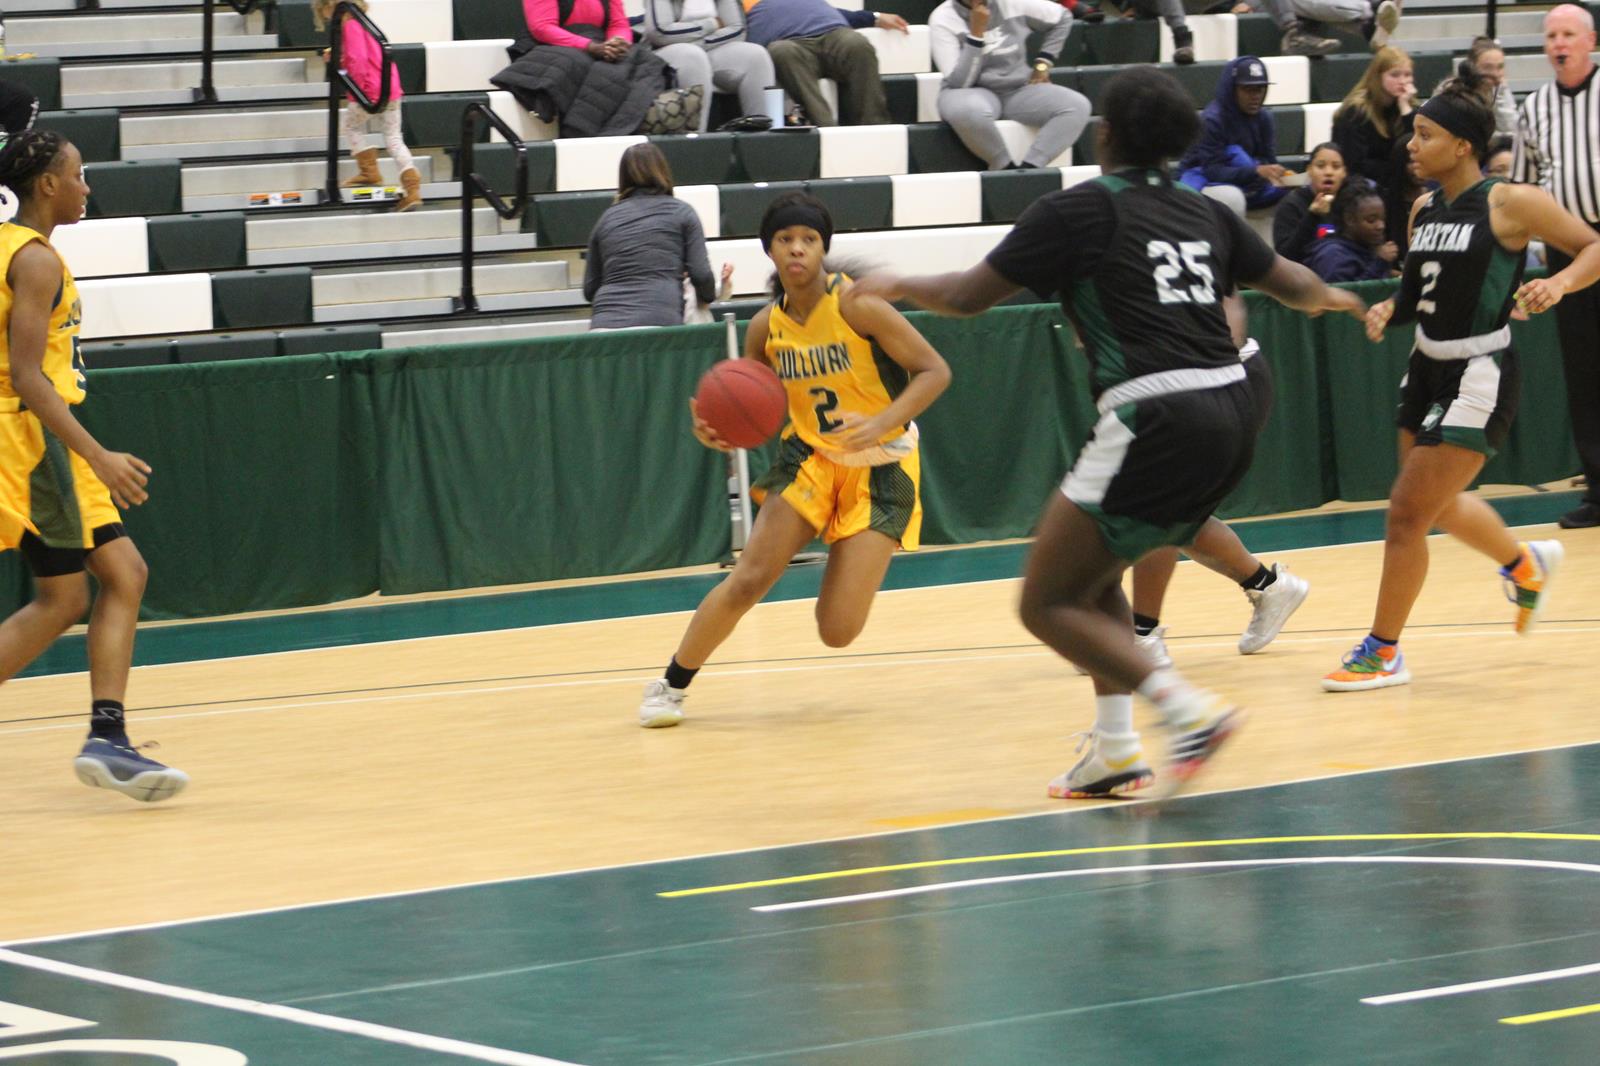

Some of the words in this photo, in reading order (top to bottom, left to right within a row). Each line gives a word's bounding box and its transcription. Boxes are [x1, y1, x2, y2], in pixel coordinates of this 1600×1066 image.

[1408, 222, 1476, 253] ARITAN
[1146, 239, 1217, 304] 25
[1415, 260, 1442, 315] 2
[809, 387, 845, 433] 2
